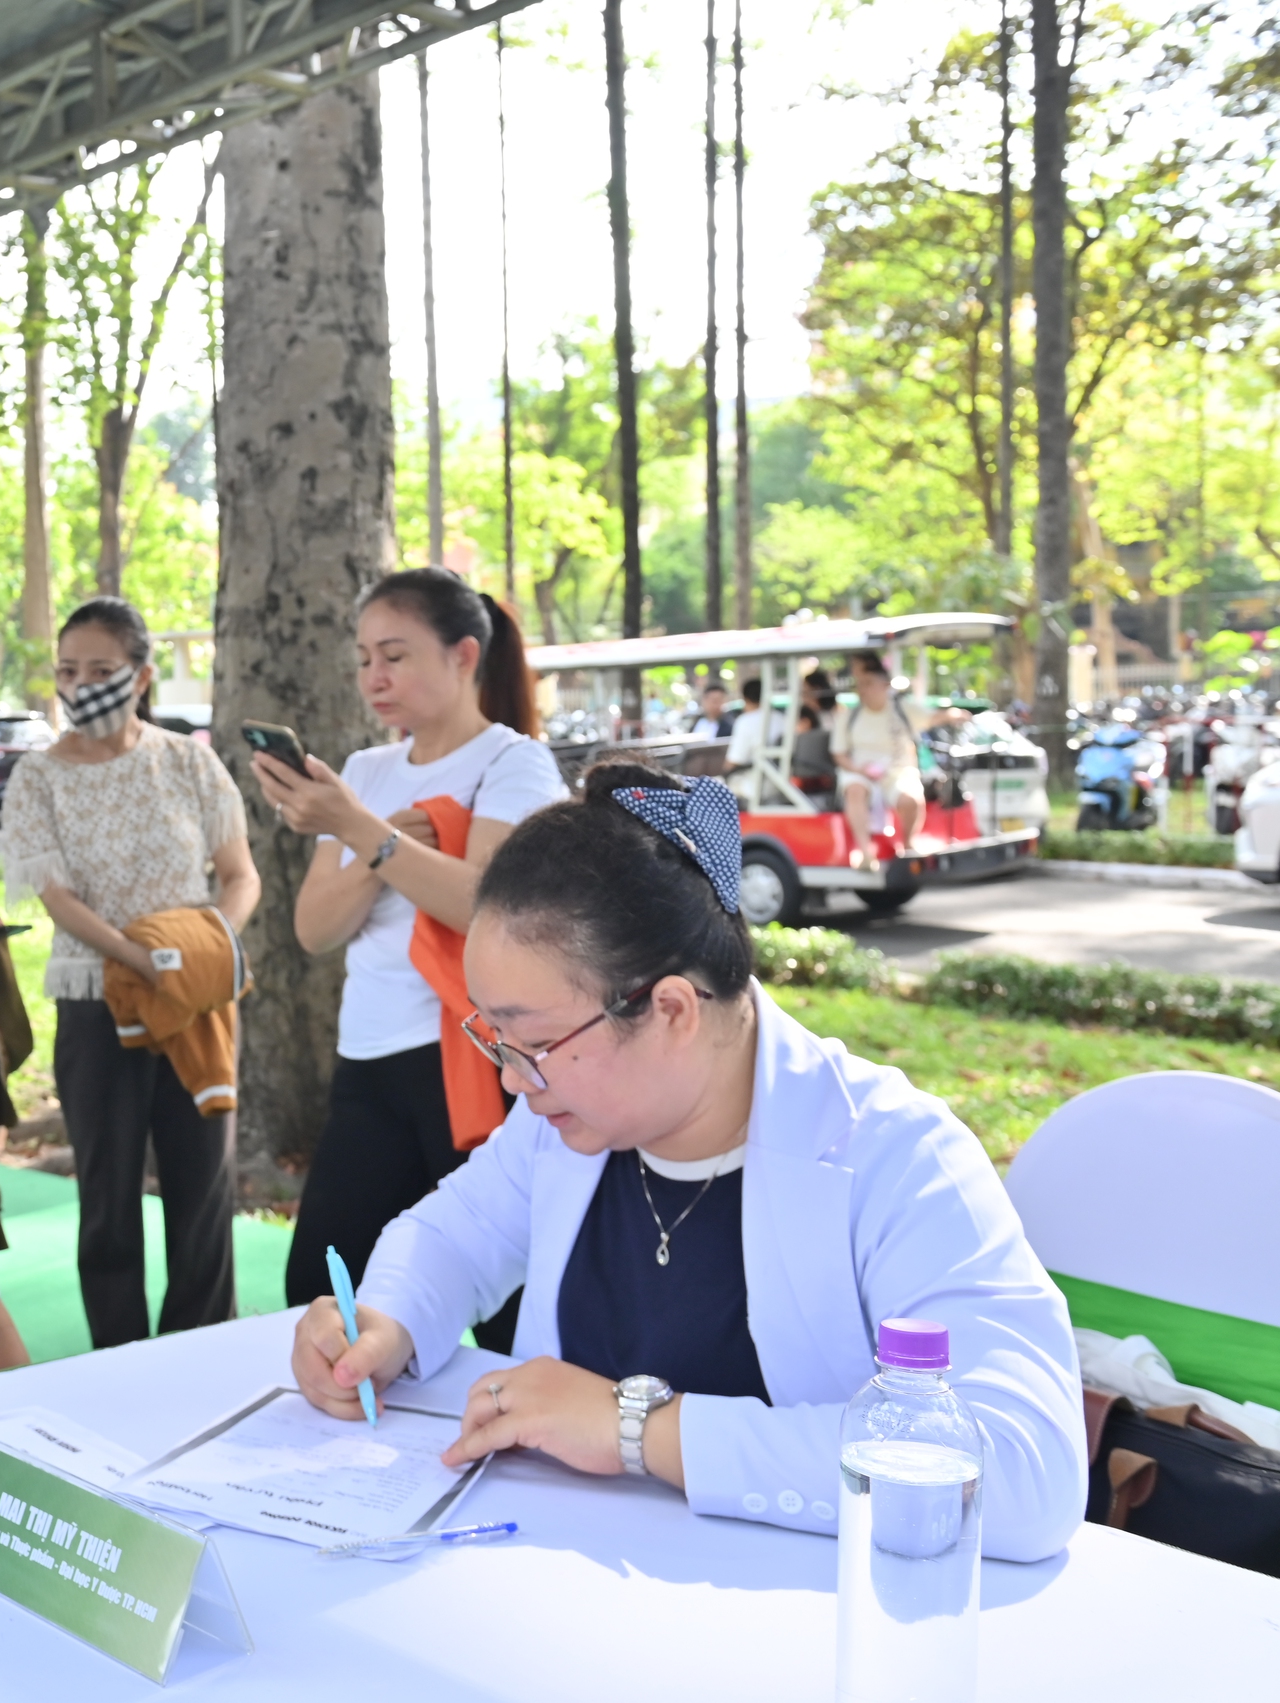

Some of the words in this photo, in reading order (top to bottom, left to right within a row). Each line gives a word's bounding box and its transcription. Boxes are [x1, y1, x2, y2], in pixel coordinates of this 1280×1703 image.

[25, 1505, 54, 1542] THỊ
[50, 1518, 78, 1550] MỸ
[76, 1530, 122, 1574] THIỆN
[91, 1576, 99, 1592] Y
[122, 1592, 136, 1612] TP.
